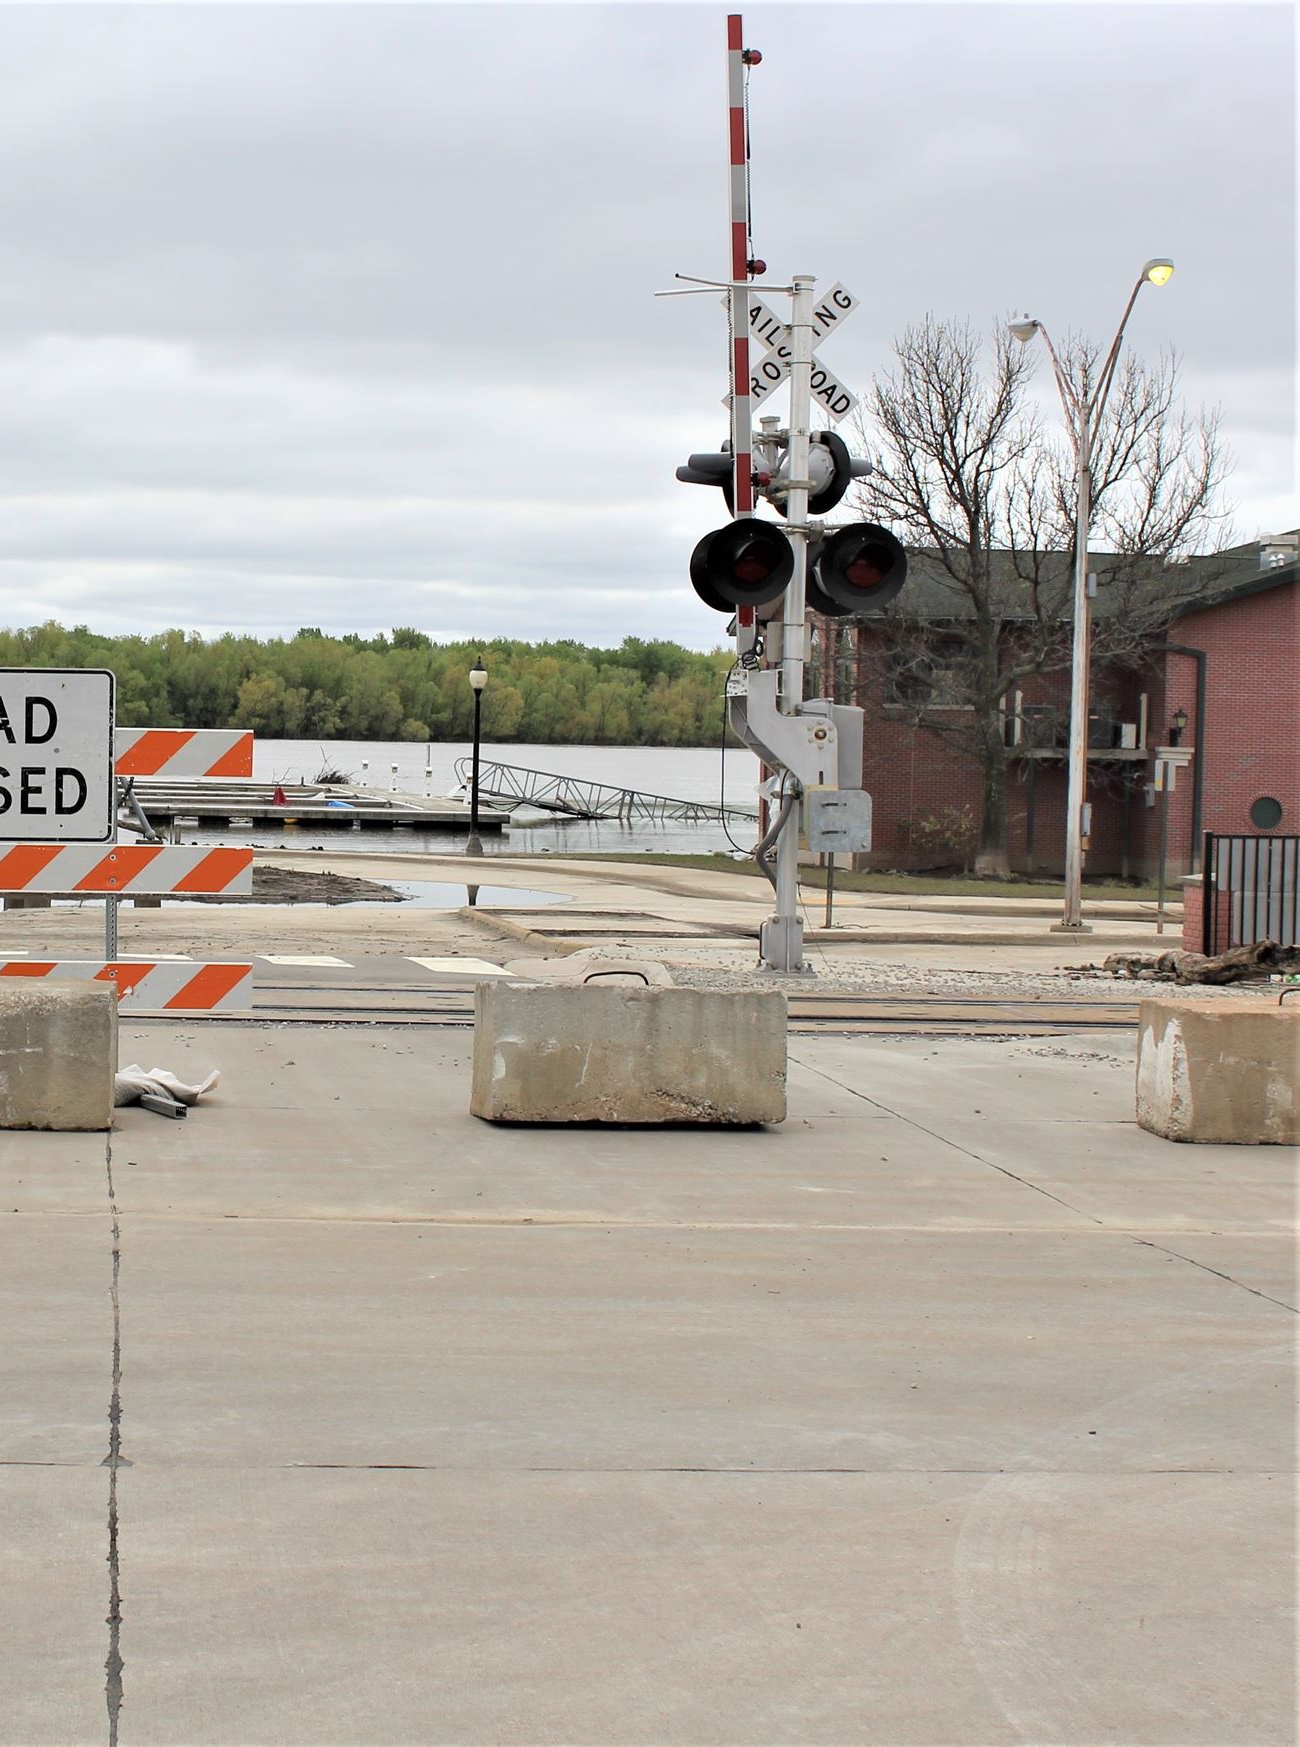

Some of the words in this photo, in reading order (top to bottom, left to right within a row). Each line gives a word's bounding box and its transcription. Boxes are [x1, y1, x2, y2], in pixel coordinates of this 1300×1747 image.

[749, 305, 781, 347] AIL
[810, 361, 851, 414] OAD
[750, 290, 852, 398] ROSNG
